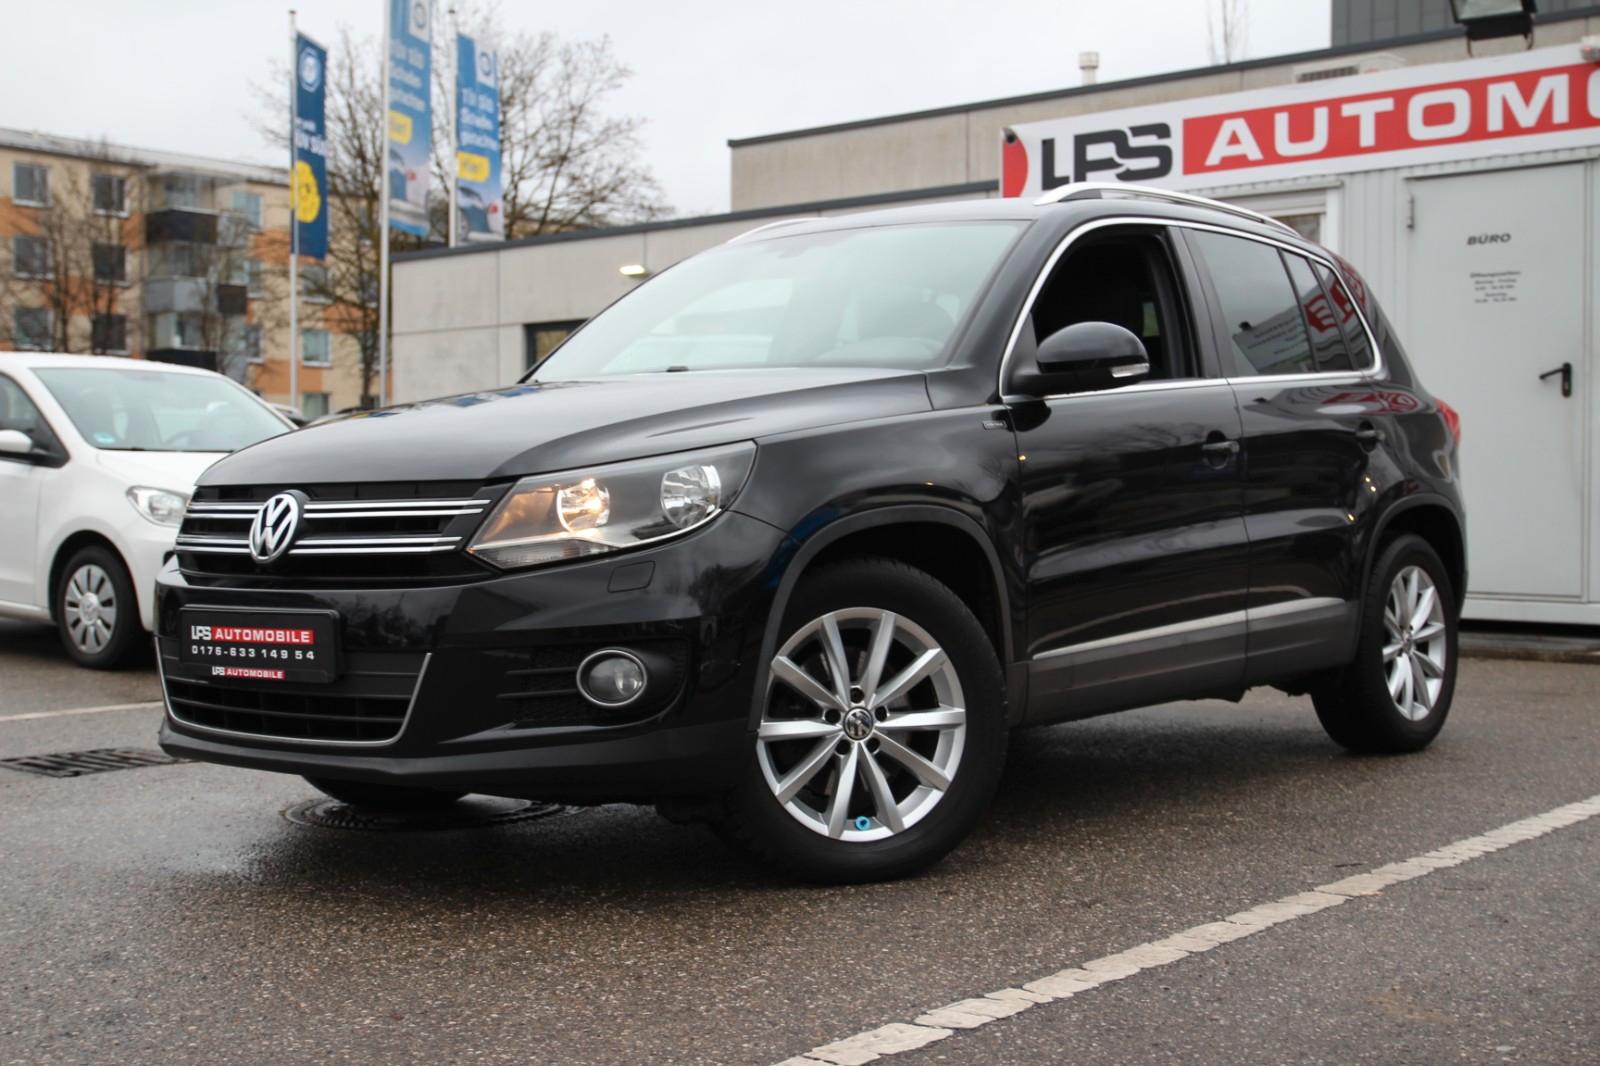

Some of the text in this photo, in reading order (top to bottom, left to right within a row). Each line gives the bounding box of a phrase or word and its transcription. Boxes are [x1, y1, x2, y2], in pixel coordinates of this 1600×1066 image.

[1041, 68, 1600, 191] LPS AUTOM
[191, 625, 311, 643] LPS AUTOMOBILE
[226, 668, 284, 679] AUTOMOBILE
